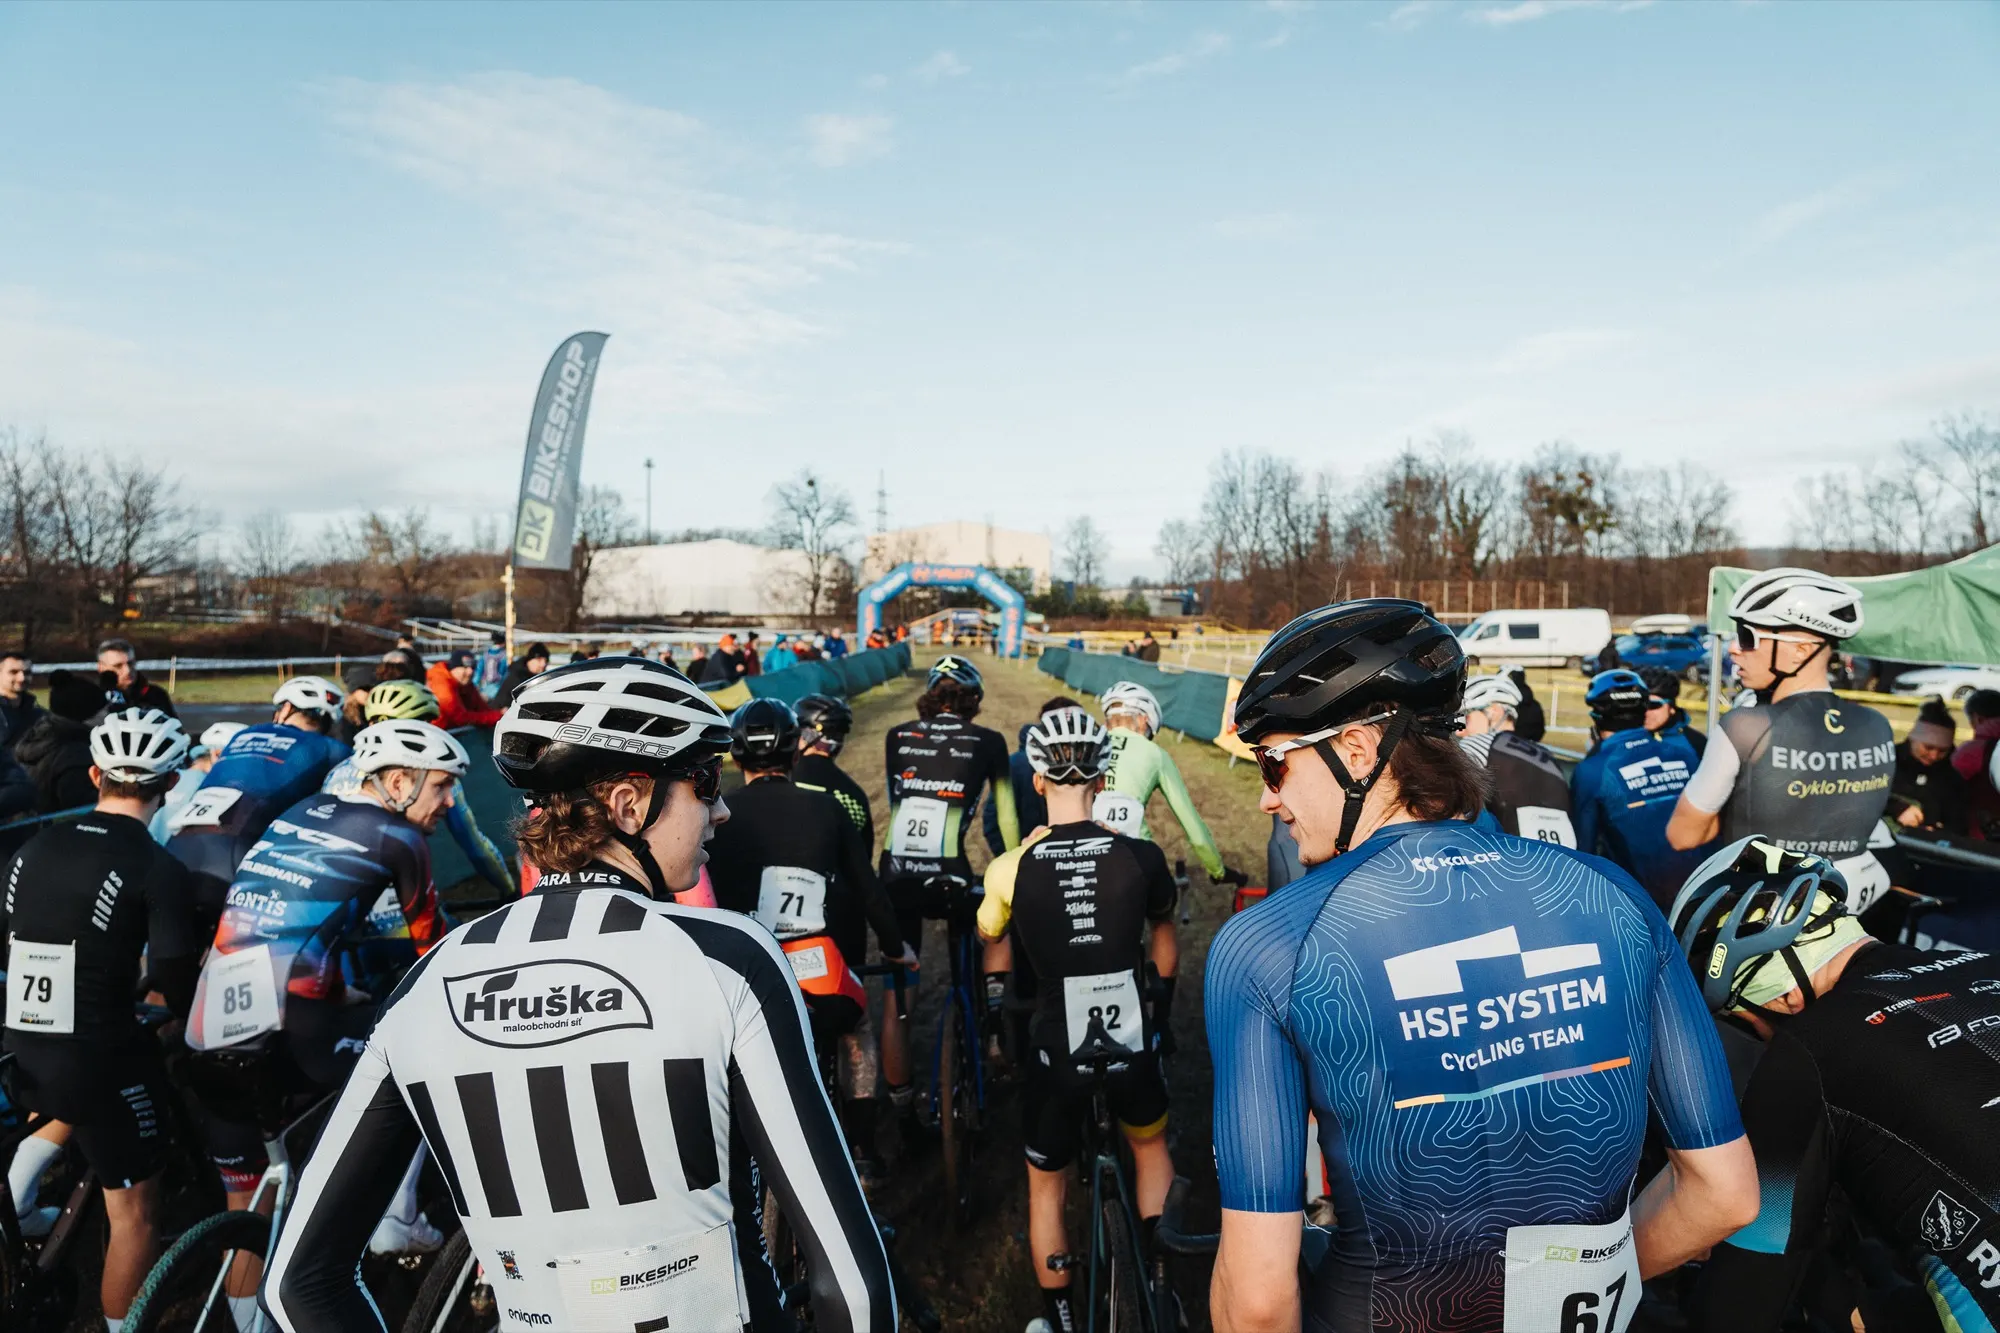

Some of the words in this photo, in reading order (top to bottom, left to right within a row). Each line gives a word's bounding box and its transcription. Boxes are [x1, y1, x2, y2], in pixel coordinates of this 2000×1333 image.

[527, 340, 587, 500] BIKESHOP
[520, 503, 547, 553] DK
[1787, 609, 1849, 635] S-WORKS
[586, 732, 676, 757] FORCE
[902, 778, 965, 792] Viktoria
[1649, 769, 1690, 784] SYSTEM
[184, 803, 212, 818] 76
[1107, 807, 1128, 821] 43
[907, 818, 929, 837] 26
[236, 860, 315, 889] ELBERMAYR
[905, 860, 942, 873] Rybnik
[1055, 860, 1096, 871] Rubena
[578, 872, 622, 885] VES
[91, 870, 124, 932] RIDERS
[779, 892, 804, 917] 71
[1710, 946, 1726, 975] ABUS
[1908, 952, 1991, 974] Rybnik
[22, 975, 53, 1004] 79
[224, 982, 253, 1014] 85
[463, 984, 623, 1023] Hruška
[1399, 1004, 1469, 1041] HSF
[1477, 975, 1607, 1030] SYSTEM
[503, 1019, 570, 1032] maloobchodní
[571, 1016, 584, 1027] síť
[1441, 1036, 1526, 1072] CYCLING
[1529, 1023, 1585, 1051] TEAM
[620, 1254, 699, 1287] BIKESHOP
[646, 1279, 665, 1288] SERVIS
[1560, 1270, 1627, 1333] 67
